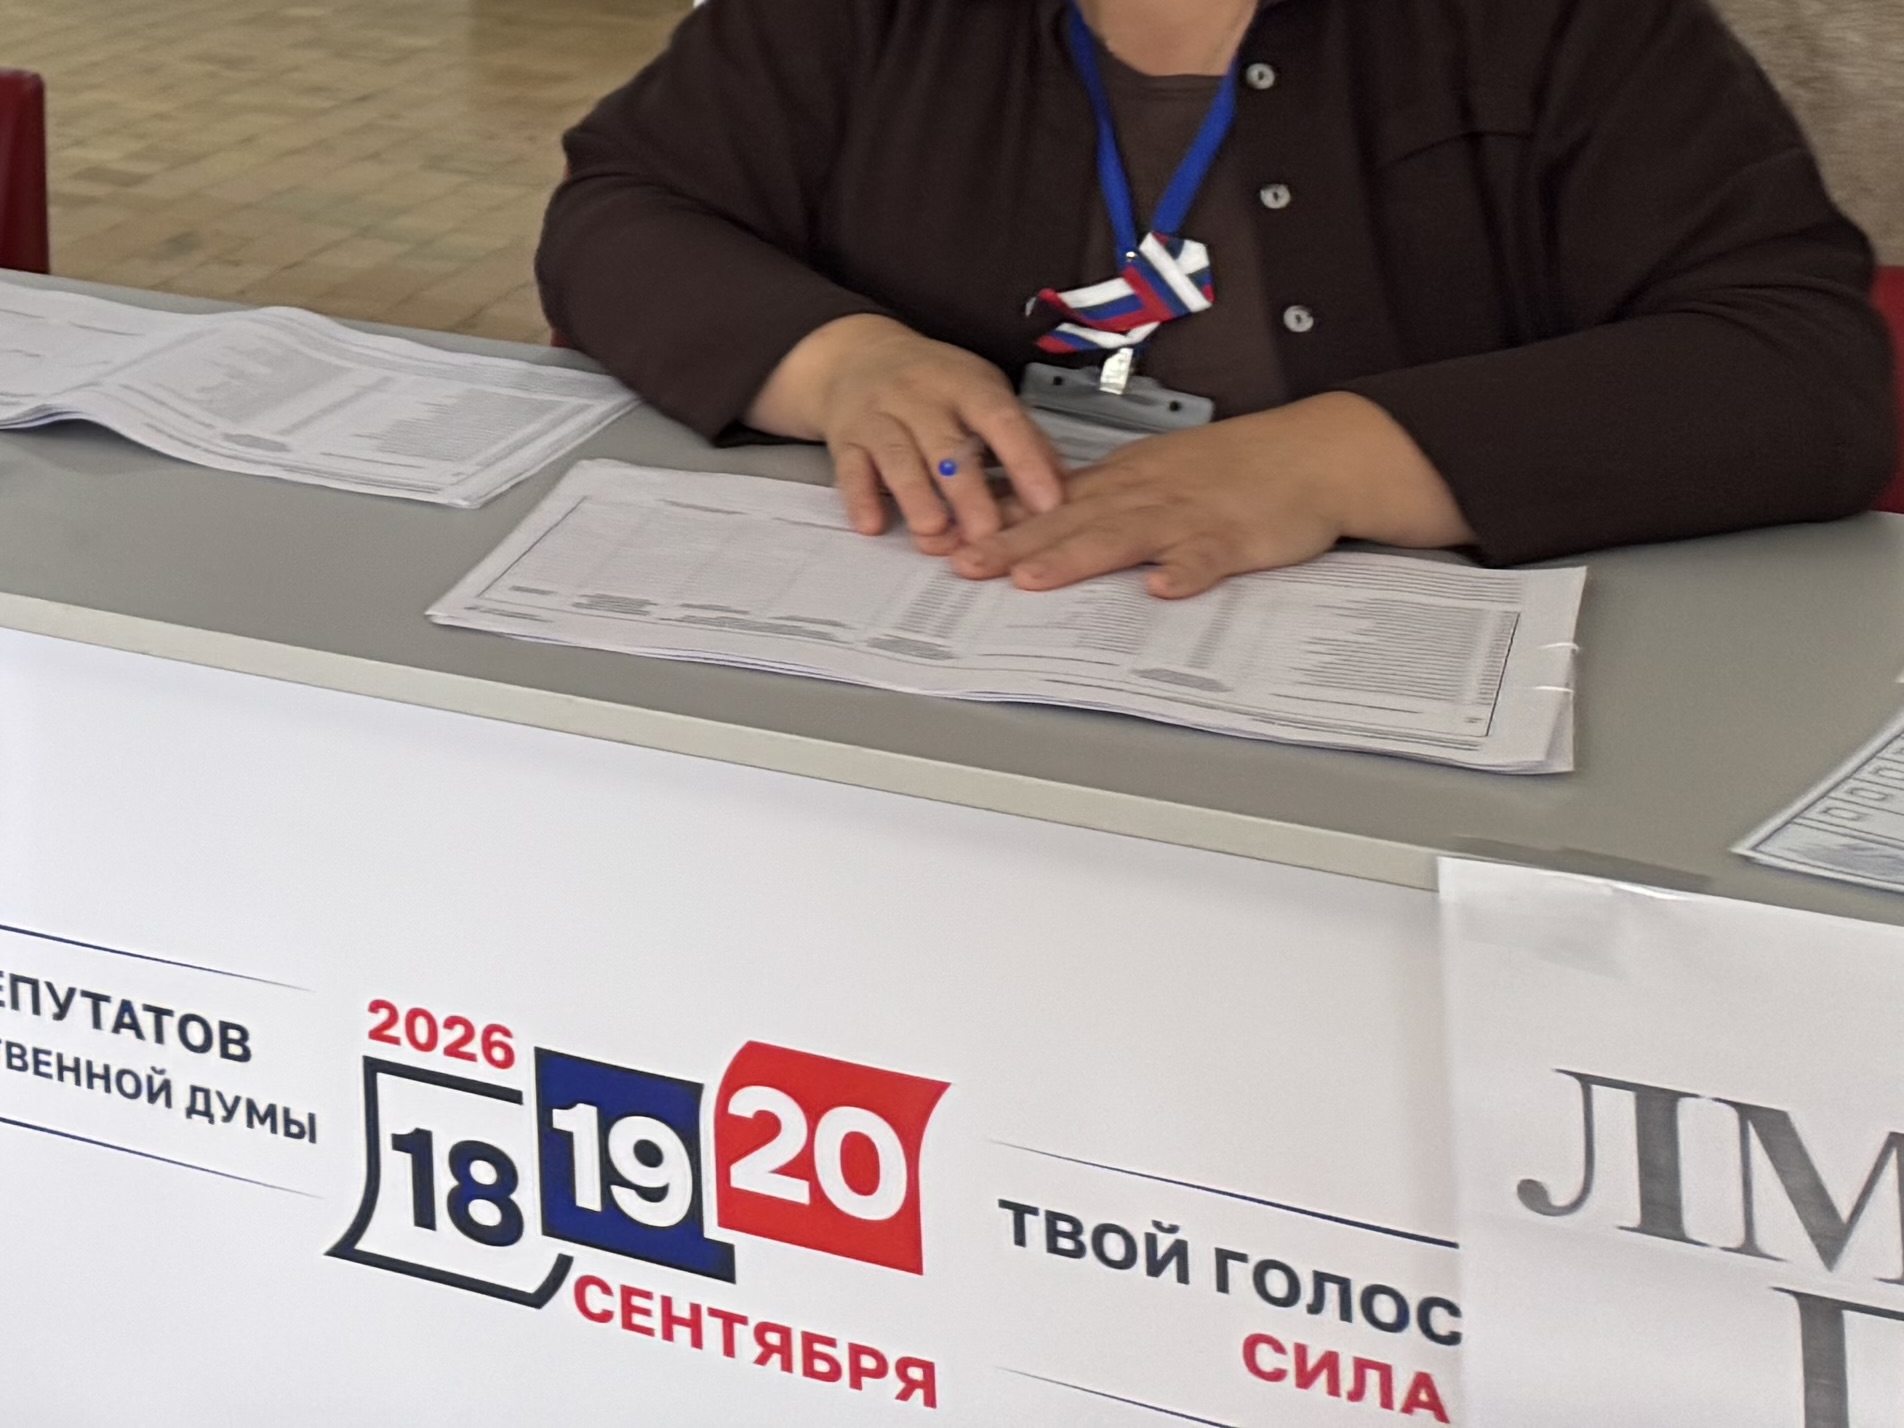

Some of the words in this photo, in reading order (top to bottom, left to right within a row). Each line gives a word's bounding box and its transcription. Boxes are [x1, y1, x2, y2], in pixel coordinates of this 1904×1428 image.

[367, 999, 517, 1070] 2026
[185, 1084, 318, 1145] ДУМЫ
[390, 1127, 526, 1248] 18
[551, 1102, 695, 1228] 19
[727, 1085, 910, 1222] 20
[997, 1198, 1192, 1287] ТВОЙ
[1214, 1246, 1463, 1348] ГОЛОС
[573, 1274, 938, 1410] СЕНТЯБРЯ
[1242, 1332, 1452, 1426] СИЛА
